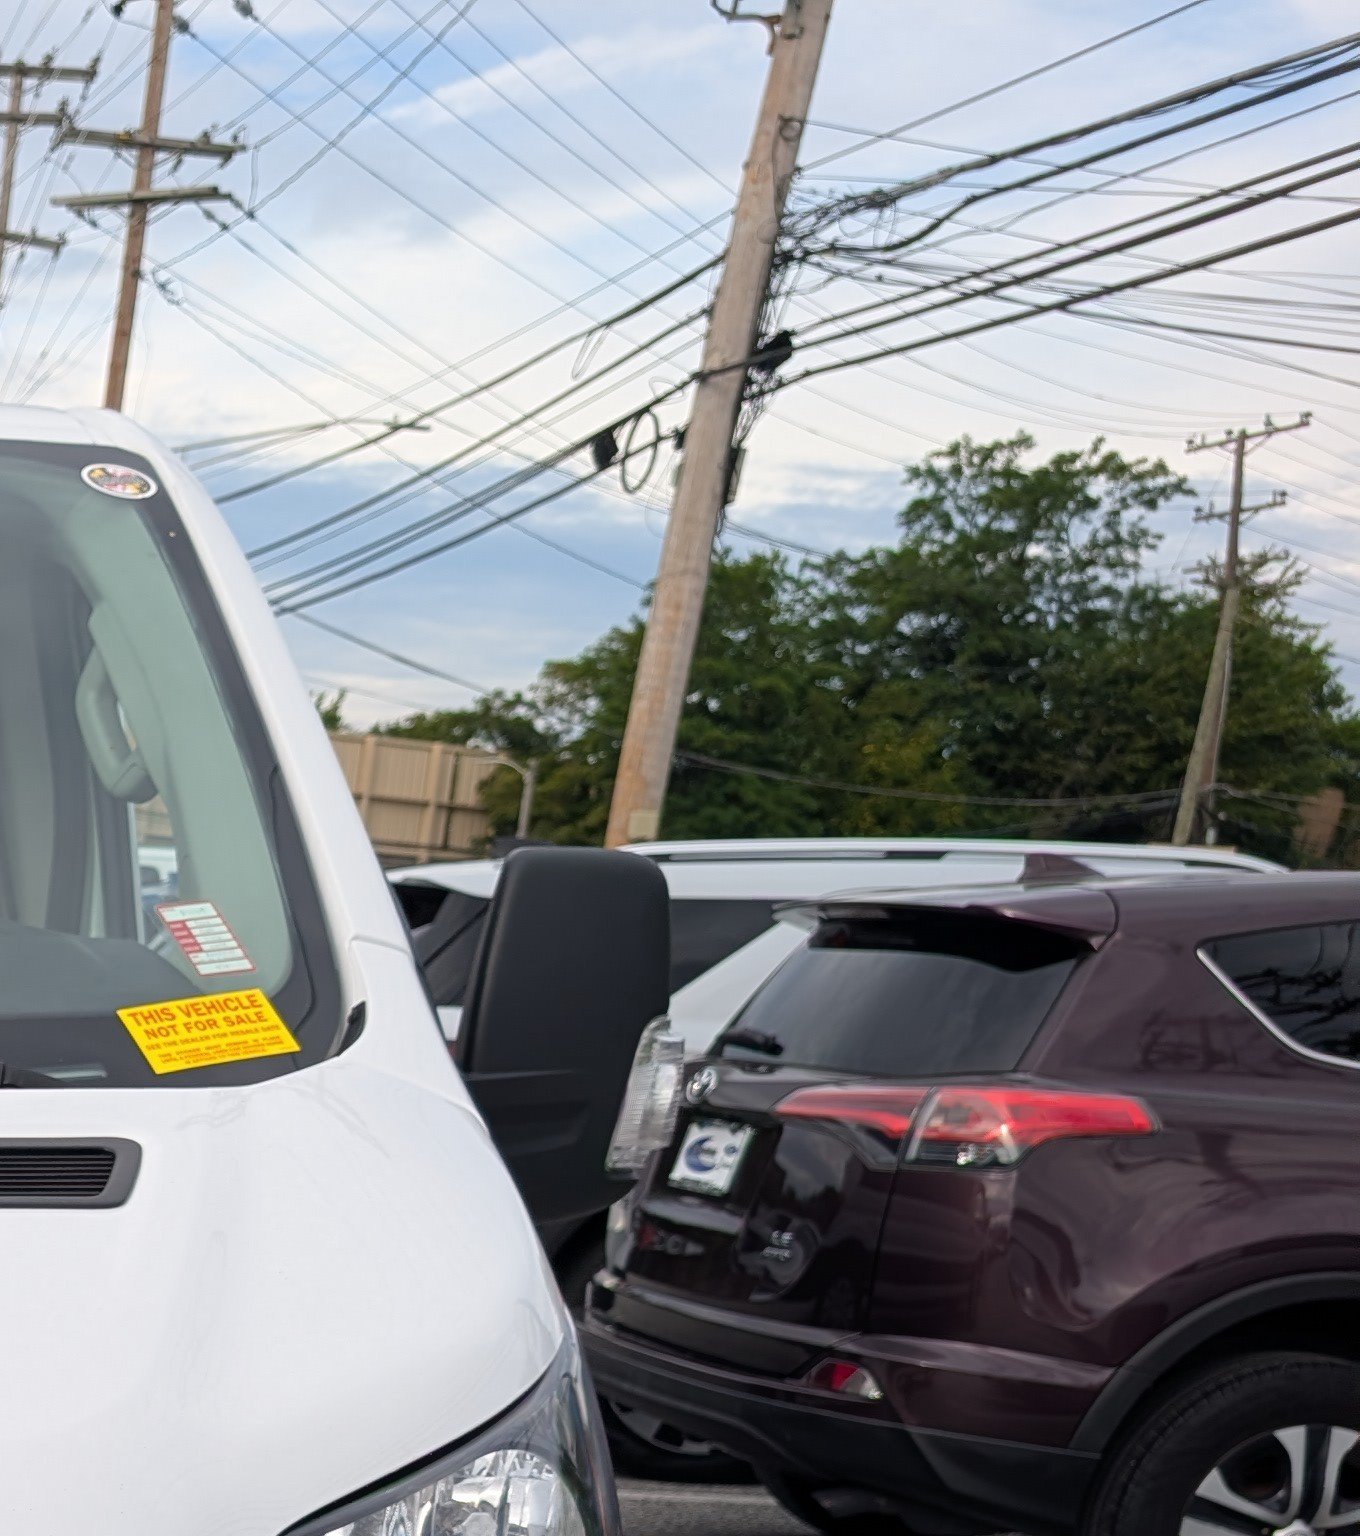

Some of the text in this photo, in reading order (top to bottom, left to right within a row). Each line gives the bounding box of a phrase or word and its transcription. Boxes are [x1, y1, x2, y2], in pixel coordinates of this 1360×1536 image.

[128, 993, 263, 1027] THIS VEHICLE
[143, 1010, 268, 1040] NOT FOR SALE
